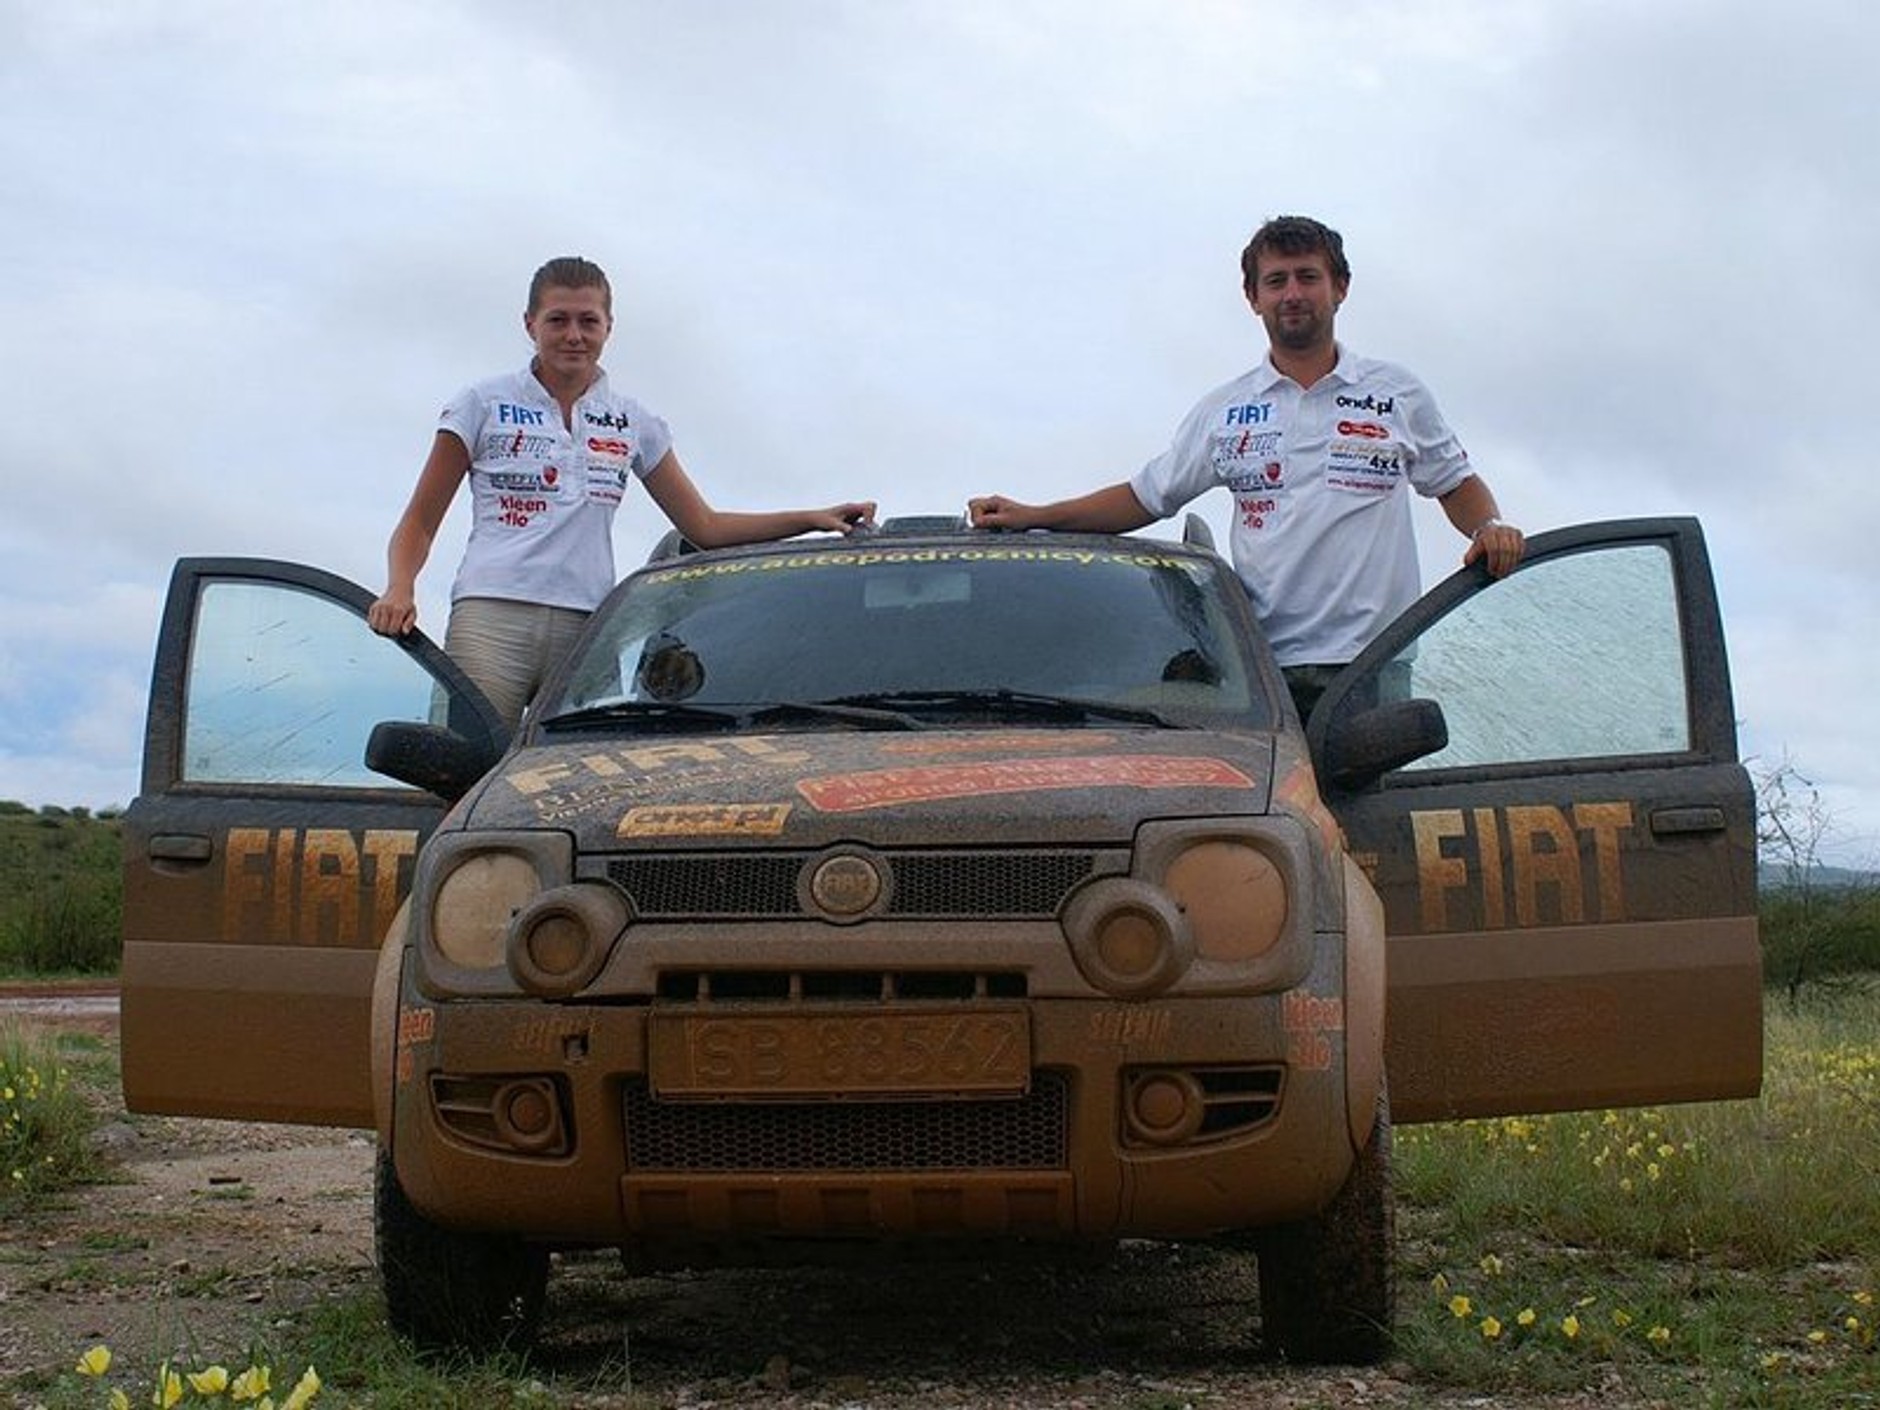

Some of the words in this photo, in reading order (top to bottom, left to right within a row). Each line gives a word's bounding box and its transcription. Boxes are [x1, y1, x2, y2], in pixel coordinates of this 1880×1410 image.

[500, 404, 544, 426] FIAT
[1227, 404, 1272, 426] FIAT
[1336, 395, 1394, 416] onet.pl
[1369, 454, 1400, 471] 4x4
[646, 550, 1198, 585] www.autopodroznicy.com
[505, 735, 780, 795] FIAT
[1410, 802, 1634, 933] FIAT
[223, 827, 420, 944] FIAT
[699, 1018, 790, 1082] SB
